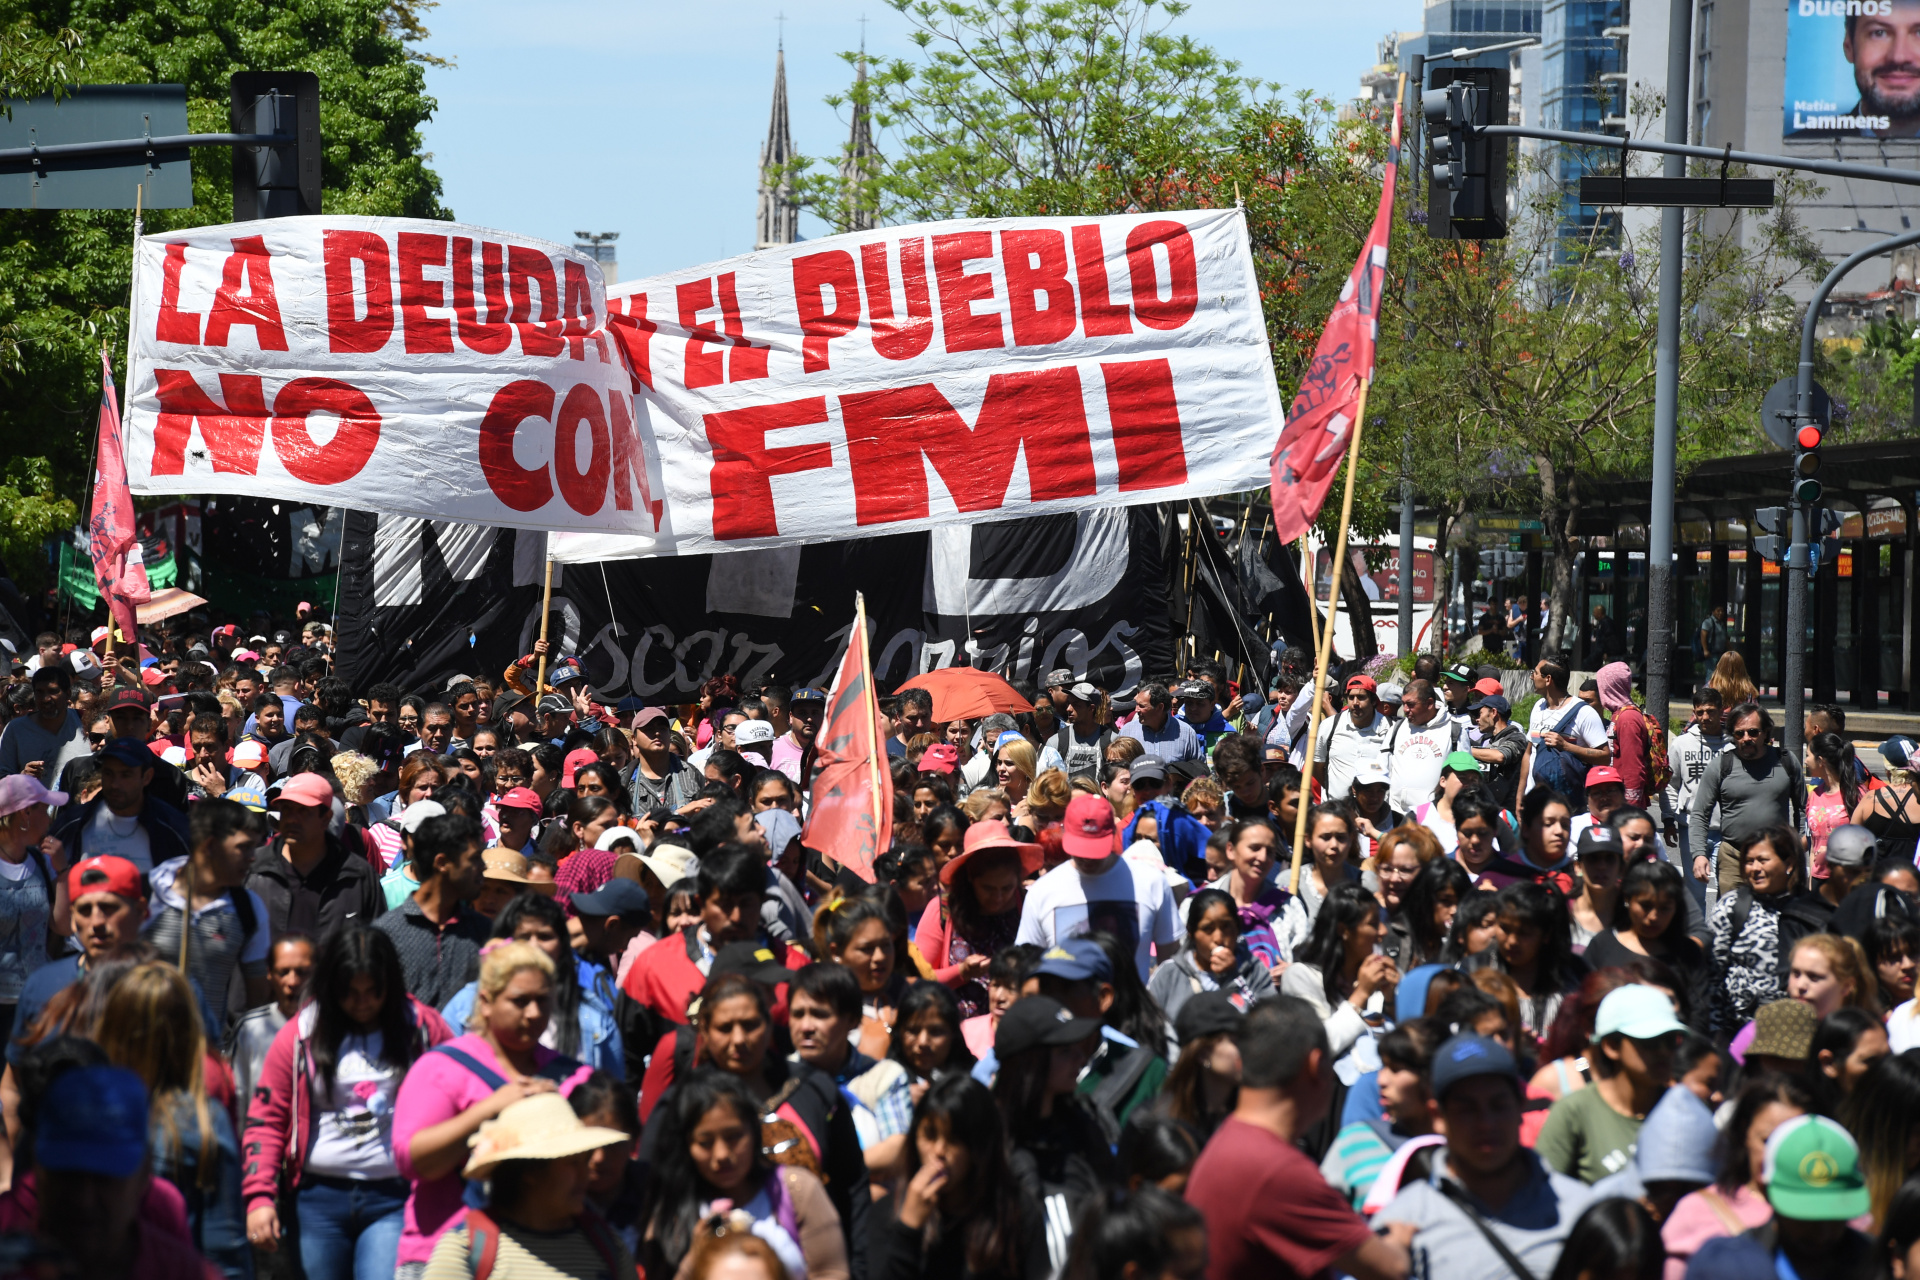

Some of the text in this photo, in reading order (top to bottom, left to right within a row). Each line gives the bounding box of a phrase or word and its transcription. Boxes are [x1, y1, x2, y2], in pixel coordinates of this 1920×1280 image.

[1798, 0, 1892, 17] buenos
[1793, 112, 1890, 130] Lammens
[156, 235, 289, 351] LA
[323, 230, 610, 364] DEUDA
[676, 271, 770, 390] EL
[793, 220, 1198, 373] PUEBLO
[151, 369, 382, 485] NO
[703, 358, 1188, 541] FMI
[558, 667, 571, 679] 12
[118, 689, 144, 702] ICON
[1072, 753, 1095, 762] NIKE
